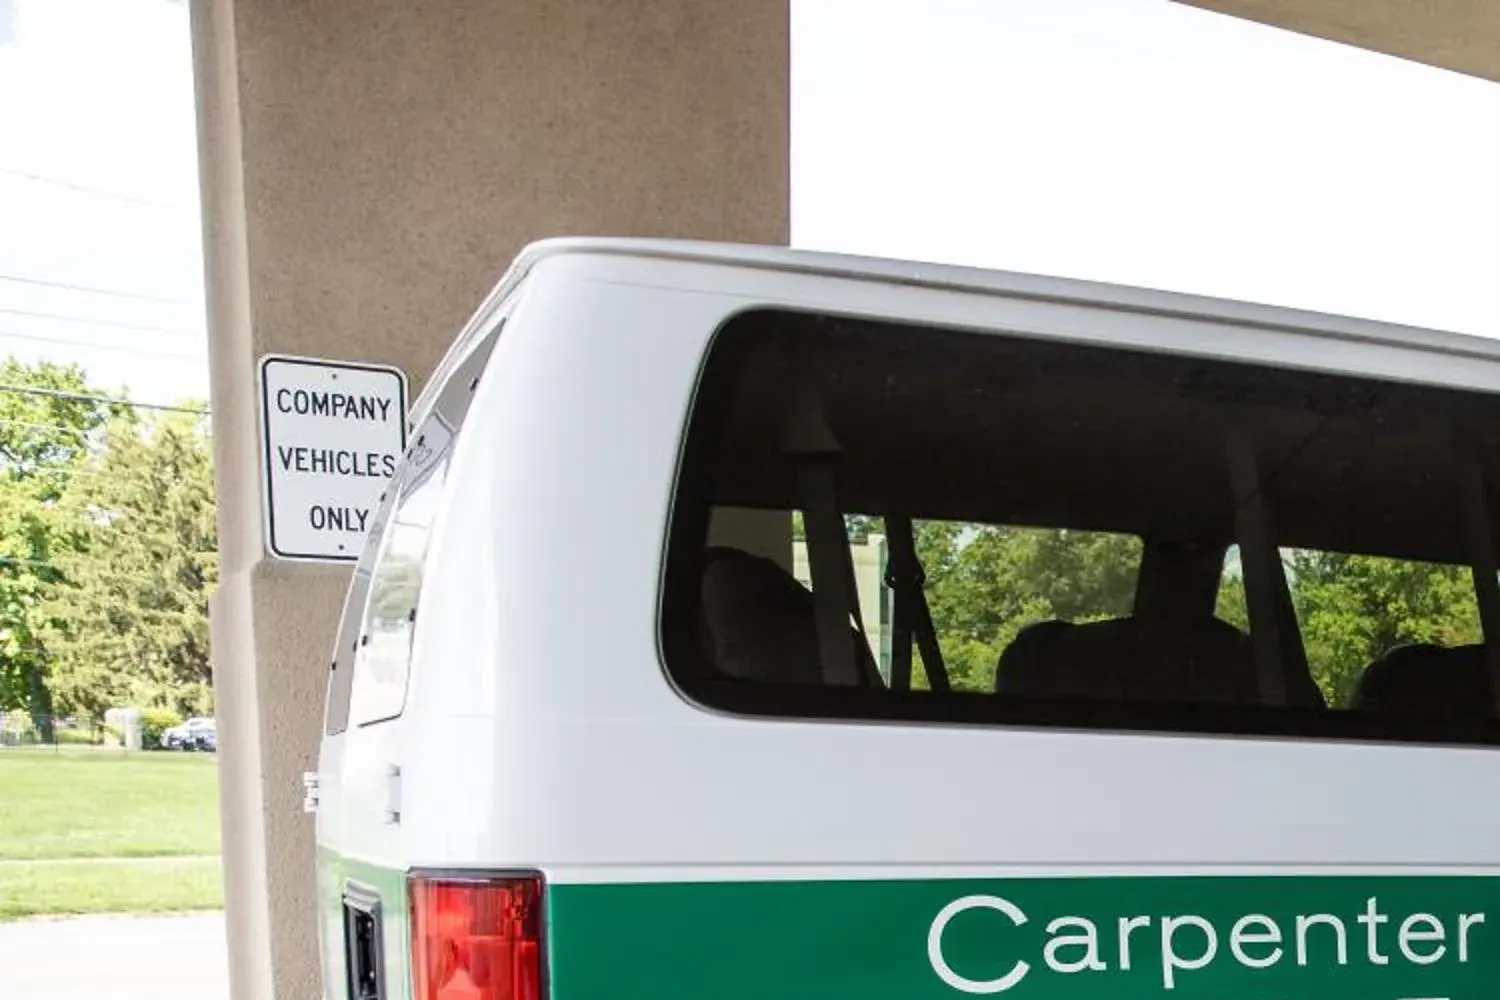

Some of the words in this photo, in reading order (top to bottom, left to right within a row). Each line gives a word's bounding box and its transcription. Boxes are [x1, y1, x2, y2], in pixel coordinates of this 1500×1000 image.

[277, 388, 391, 421] COMPANY
[278, 445, 395, 478] VEHICLES
[310, 505, 369, 532] ONLY
[927, 894, 1485, 994] Carpenter
